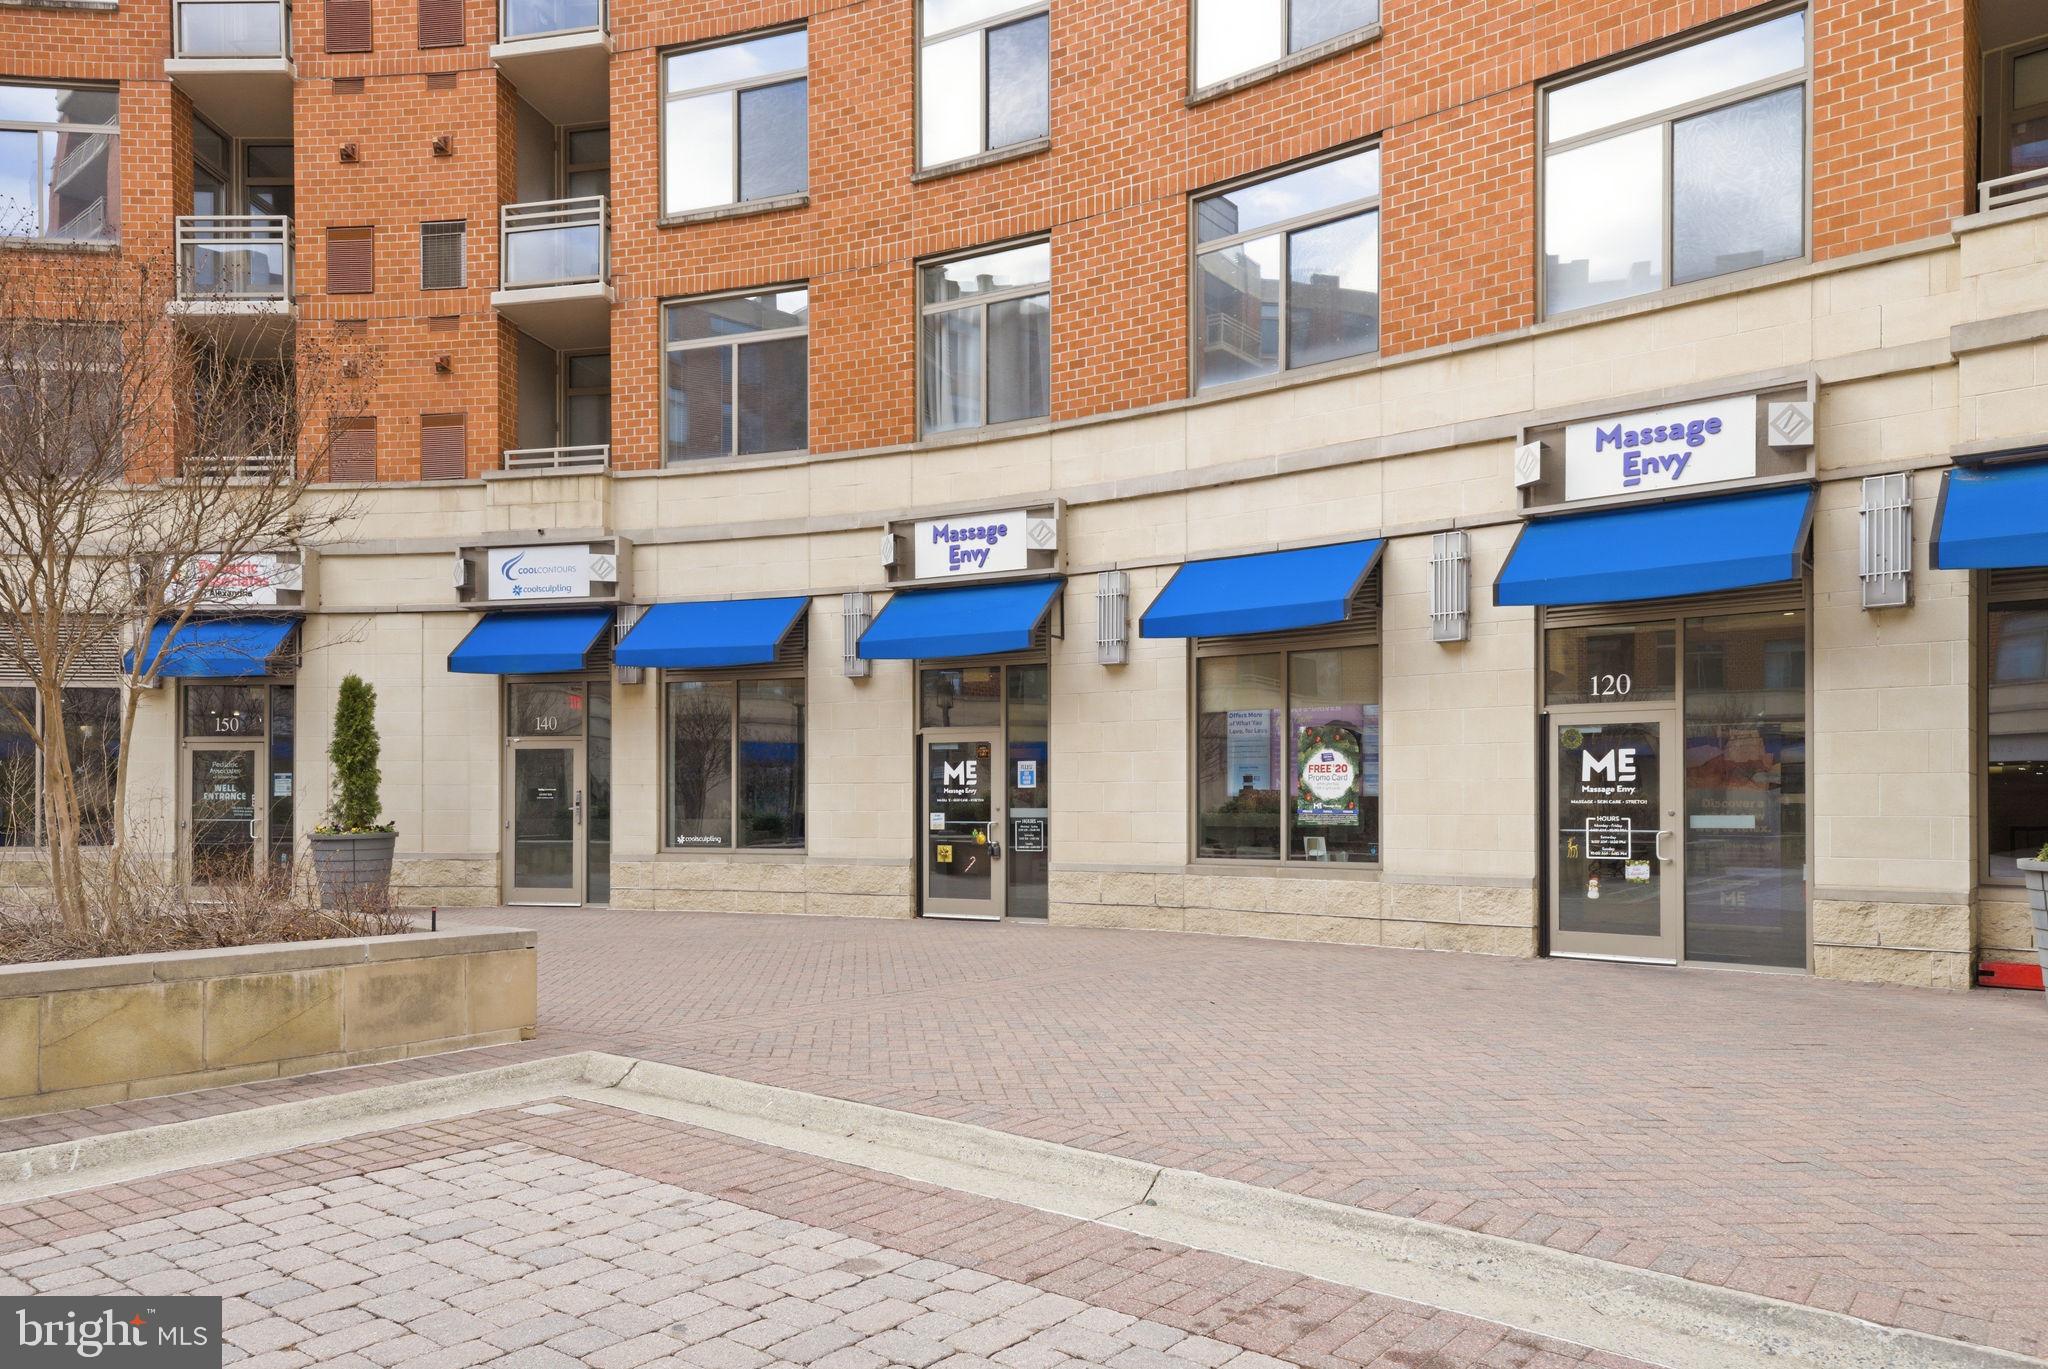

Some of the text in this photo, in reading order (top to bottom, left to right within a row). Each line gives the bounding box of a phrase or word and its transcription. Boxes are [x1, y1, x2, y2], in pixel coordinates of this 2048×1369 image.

[1596, 417, 1722, 452] Massage
[1623, 450, 1692, 487] Envy
[933, 523, 1008, 545] Massage
[949, 545, 990, 571] Envy
[518, 565, 577, 575] COOLCONTOURS
[523, 584, 572, 593] coolsculpting
[1590, 674, 1631, 696] 120
[215, 717, 239, 732] 150
[535, 716, 558, 730] 140
[1308, 764, 1332, 773] FREE
[1581, 748, 1636, 782] ME
[943, 760, 977, 785] ME
[1308, 774, 1331, 782] Promo
[214, 784, 237, 792] WELL
[1581, 785, 1636, 796] Massage Envy
[203, 792, 247, 801] ENTRANCE
